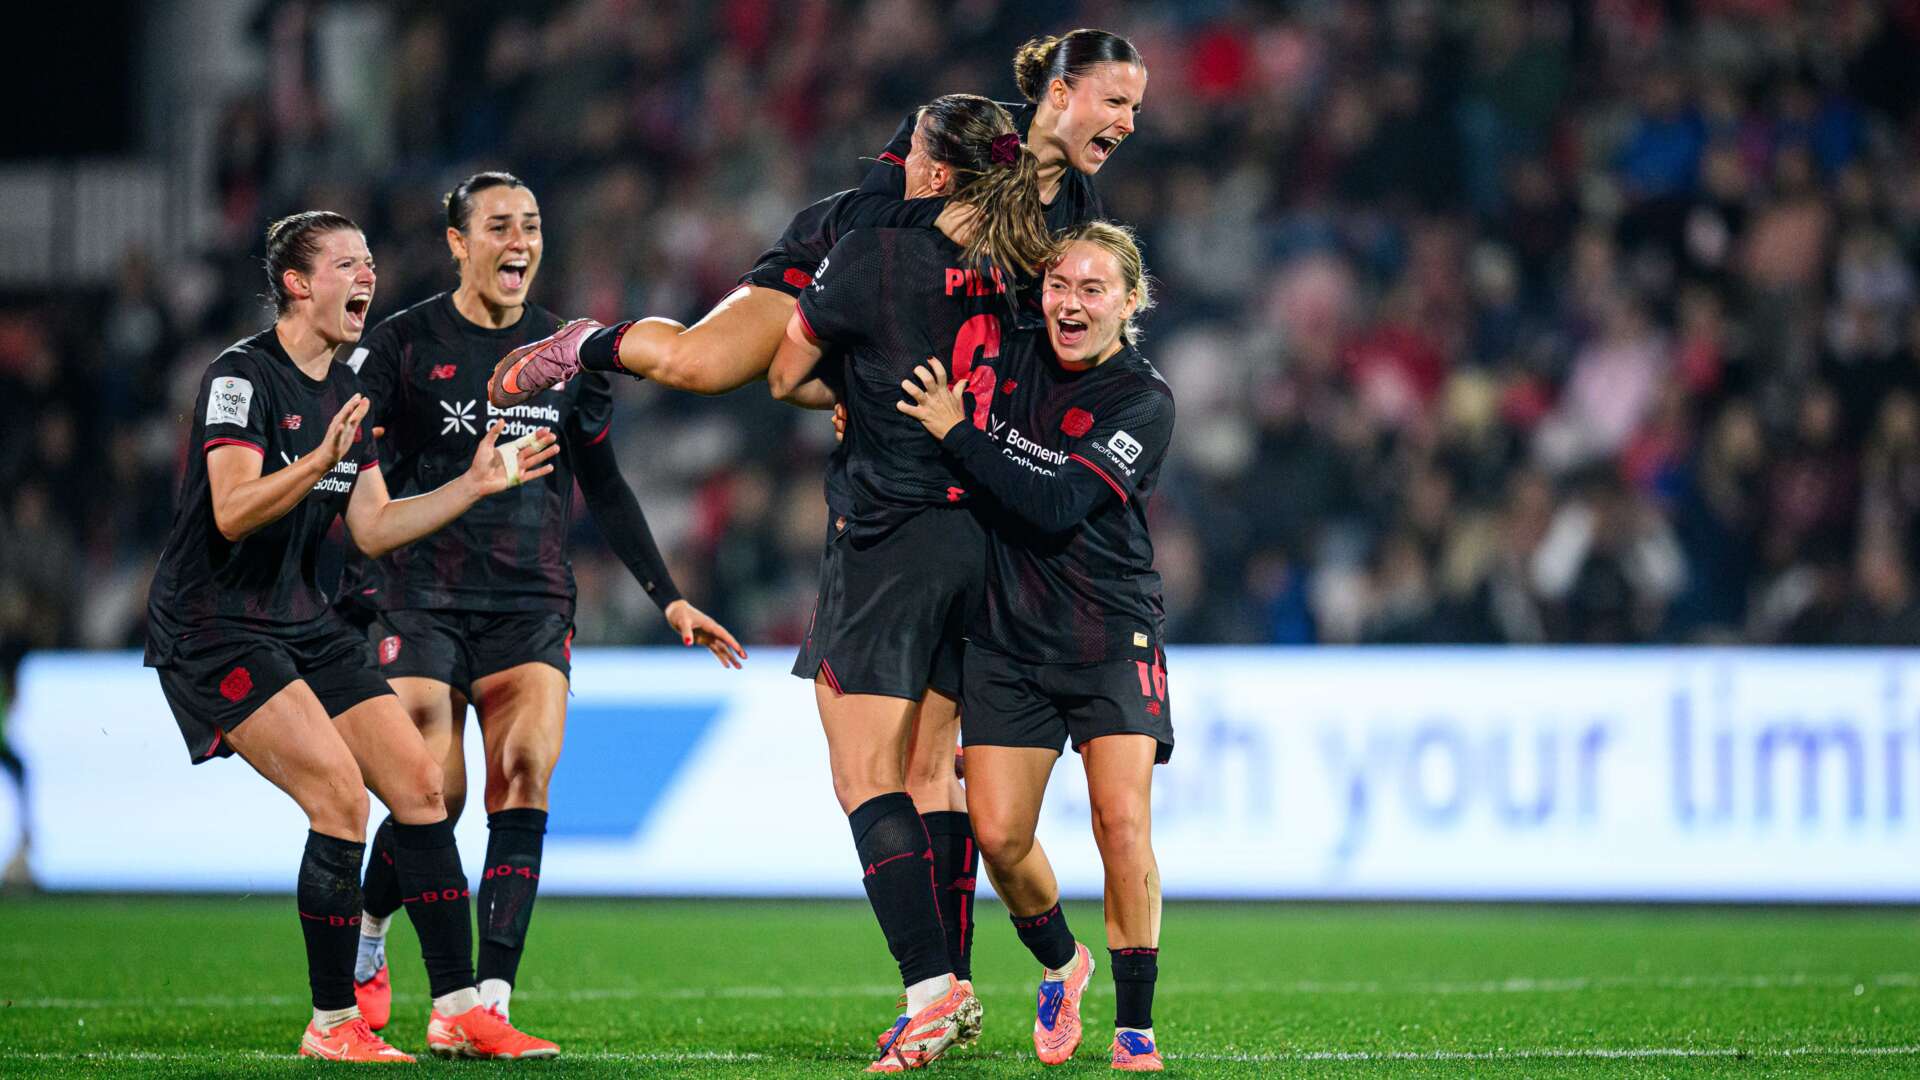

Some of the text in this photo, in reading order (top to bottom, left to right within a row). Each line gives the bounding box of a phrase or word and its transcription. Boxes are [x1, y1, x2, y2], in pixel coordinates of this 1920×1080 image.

[951, 314, 1001, 432] 6
[1136, 643, 1167, 702] 16
[1320, 714, 1622, 878] your
[1667, 662, 1920, 828] limi
